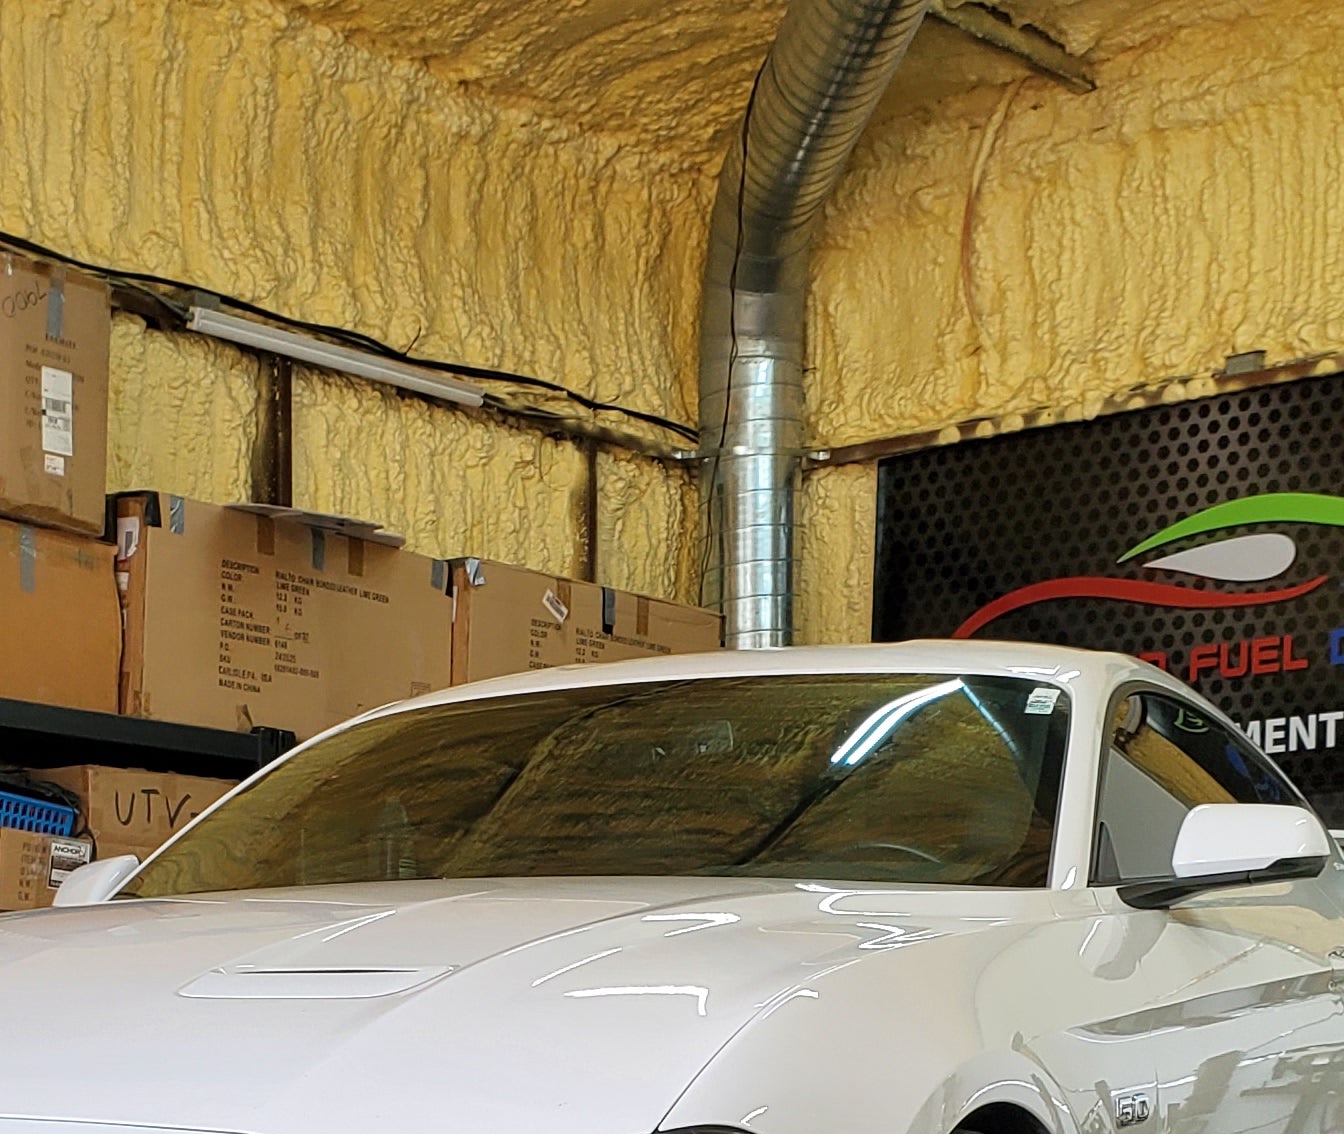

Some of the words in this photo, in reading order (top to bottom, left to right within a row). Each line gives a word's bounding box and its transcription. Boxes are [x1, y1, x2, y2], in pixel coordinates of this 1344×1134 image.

[221, 559, 260, 574] DESCRIPTION
[221, 570, 242, 581] COLOR
[220, 606, 236, 616] CASE
[220, 617, 244, 629] CARTON
[220, 629, 244, 641] VENDOR
[1188, 634, 1309, 683] FUEL
[218, 679, 235, 689] MADE
[243, 683, 260, 693] CHINA
